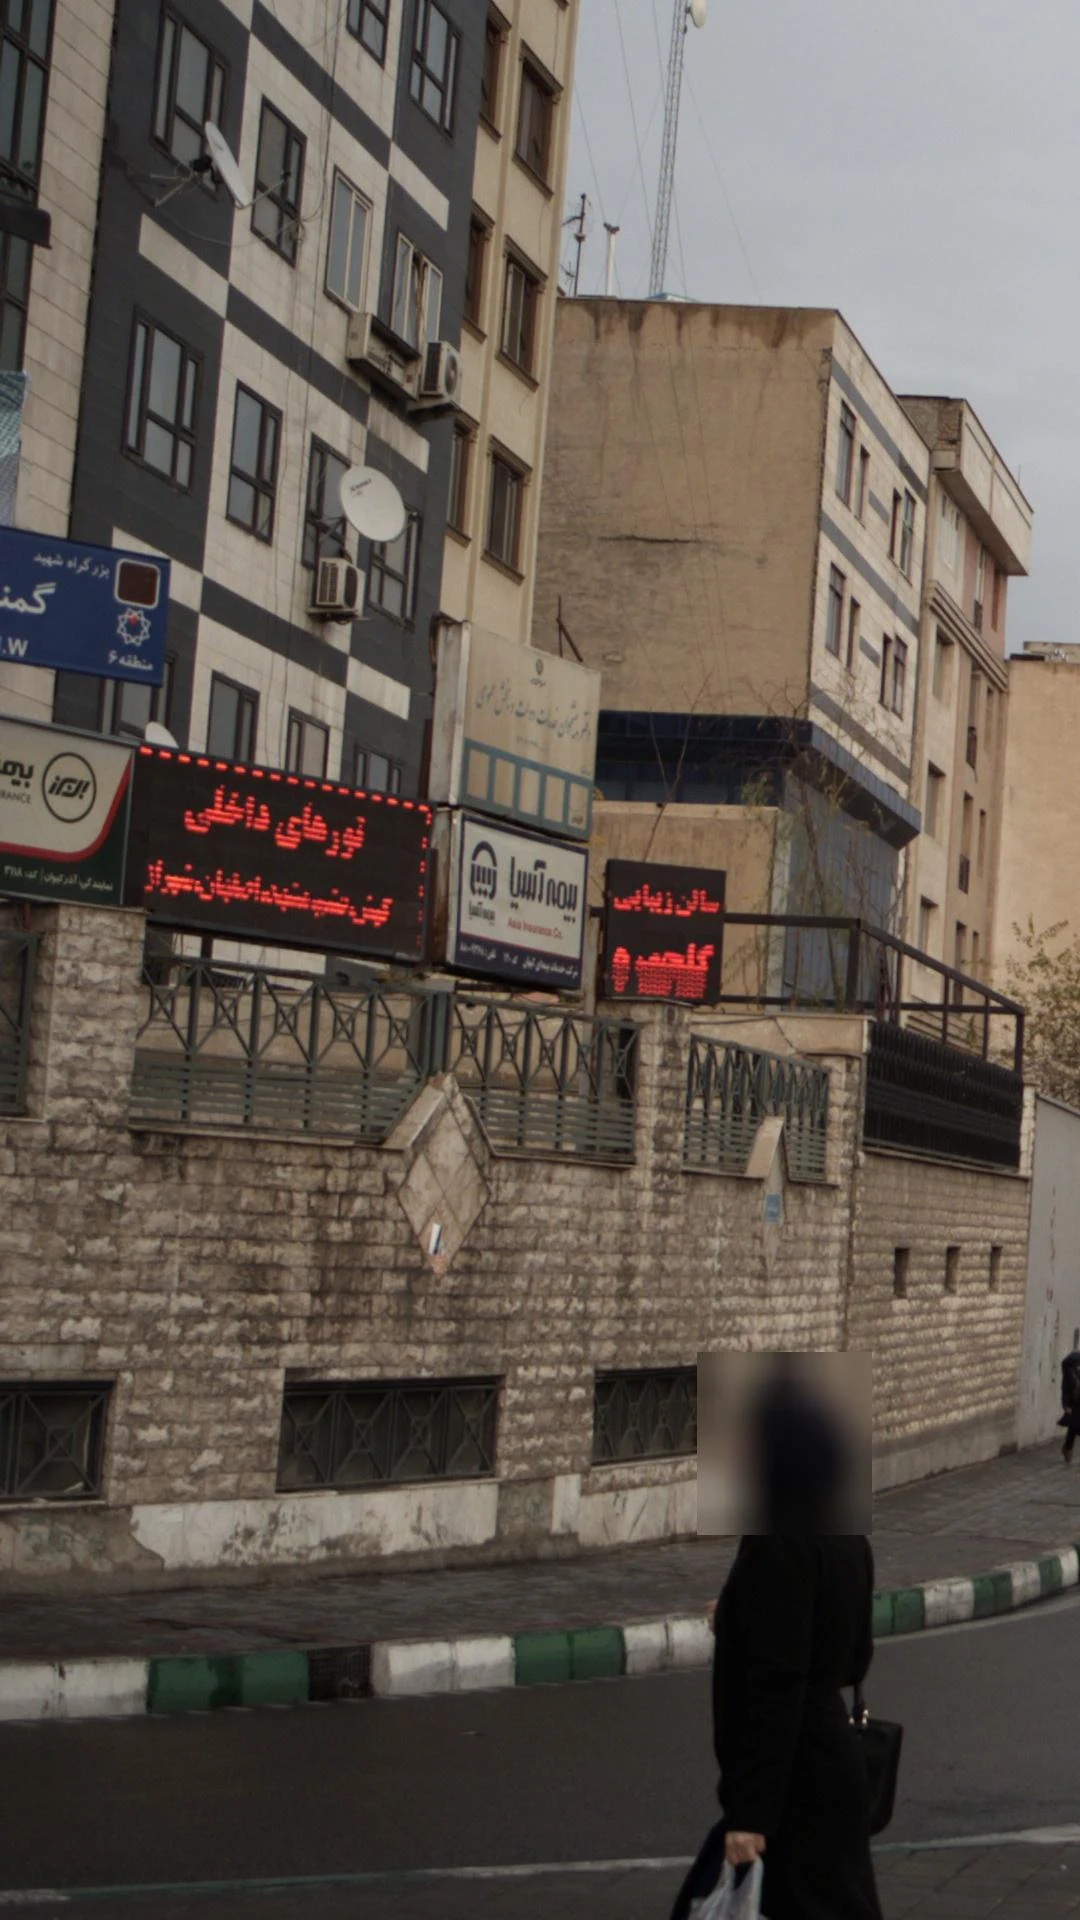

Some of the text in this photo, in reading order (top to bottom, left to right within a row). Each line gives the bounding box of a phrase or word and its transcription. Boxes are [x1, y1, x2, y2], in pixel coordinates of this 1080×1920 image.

[33, 552, 110, 579] بزرگراه شهید
[0, 582, 57, 615] گمن
[0, 635, 28, 657] .W
[118, 653, 153, 671] منطقه
[0, 760, 34, 788] بیم
[0, 790, 31, 804] RANCE
[184, 785, 270, 834] داخلی
[509, 856, 578, 923] بیمه آسیا
[613, 884, 719, 916] سالن زیبایی
